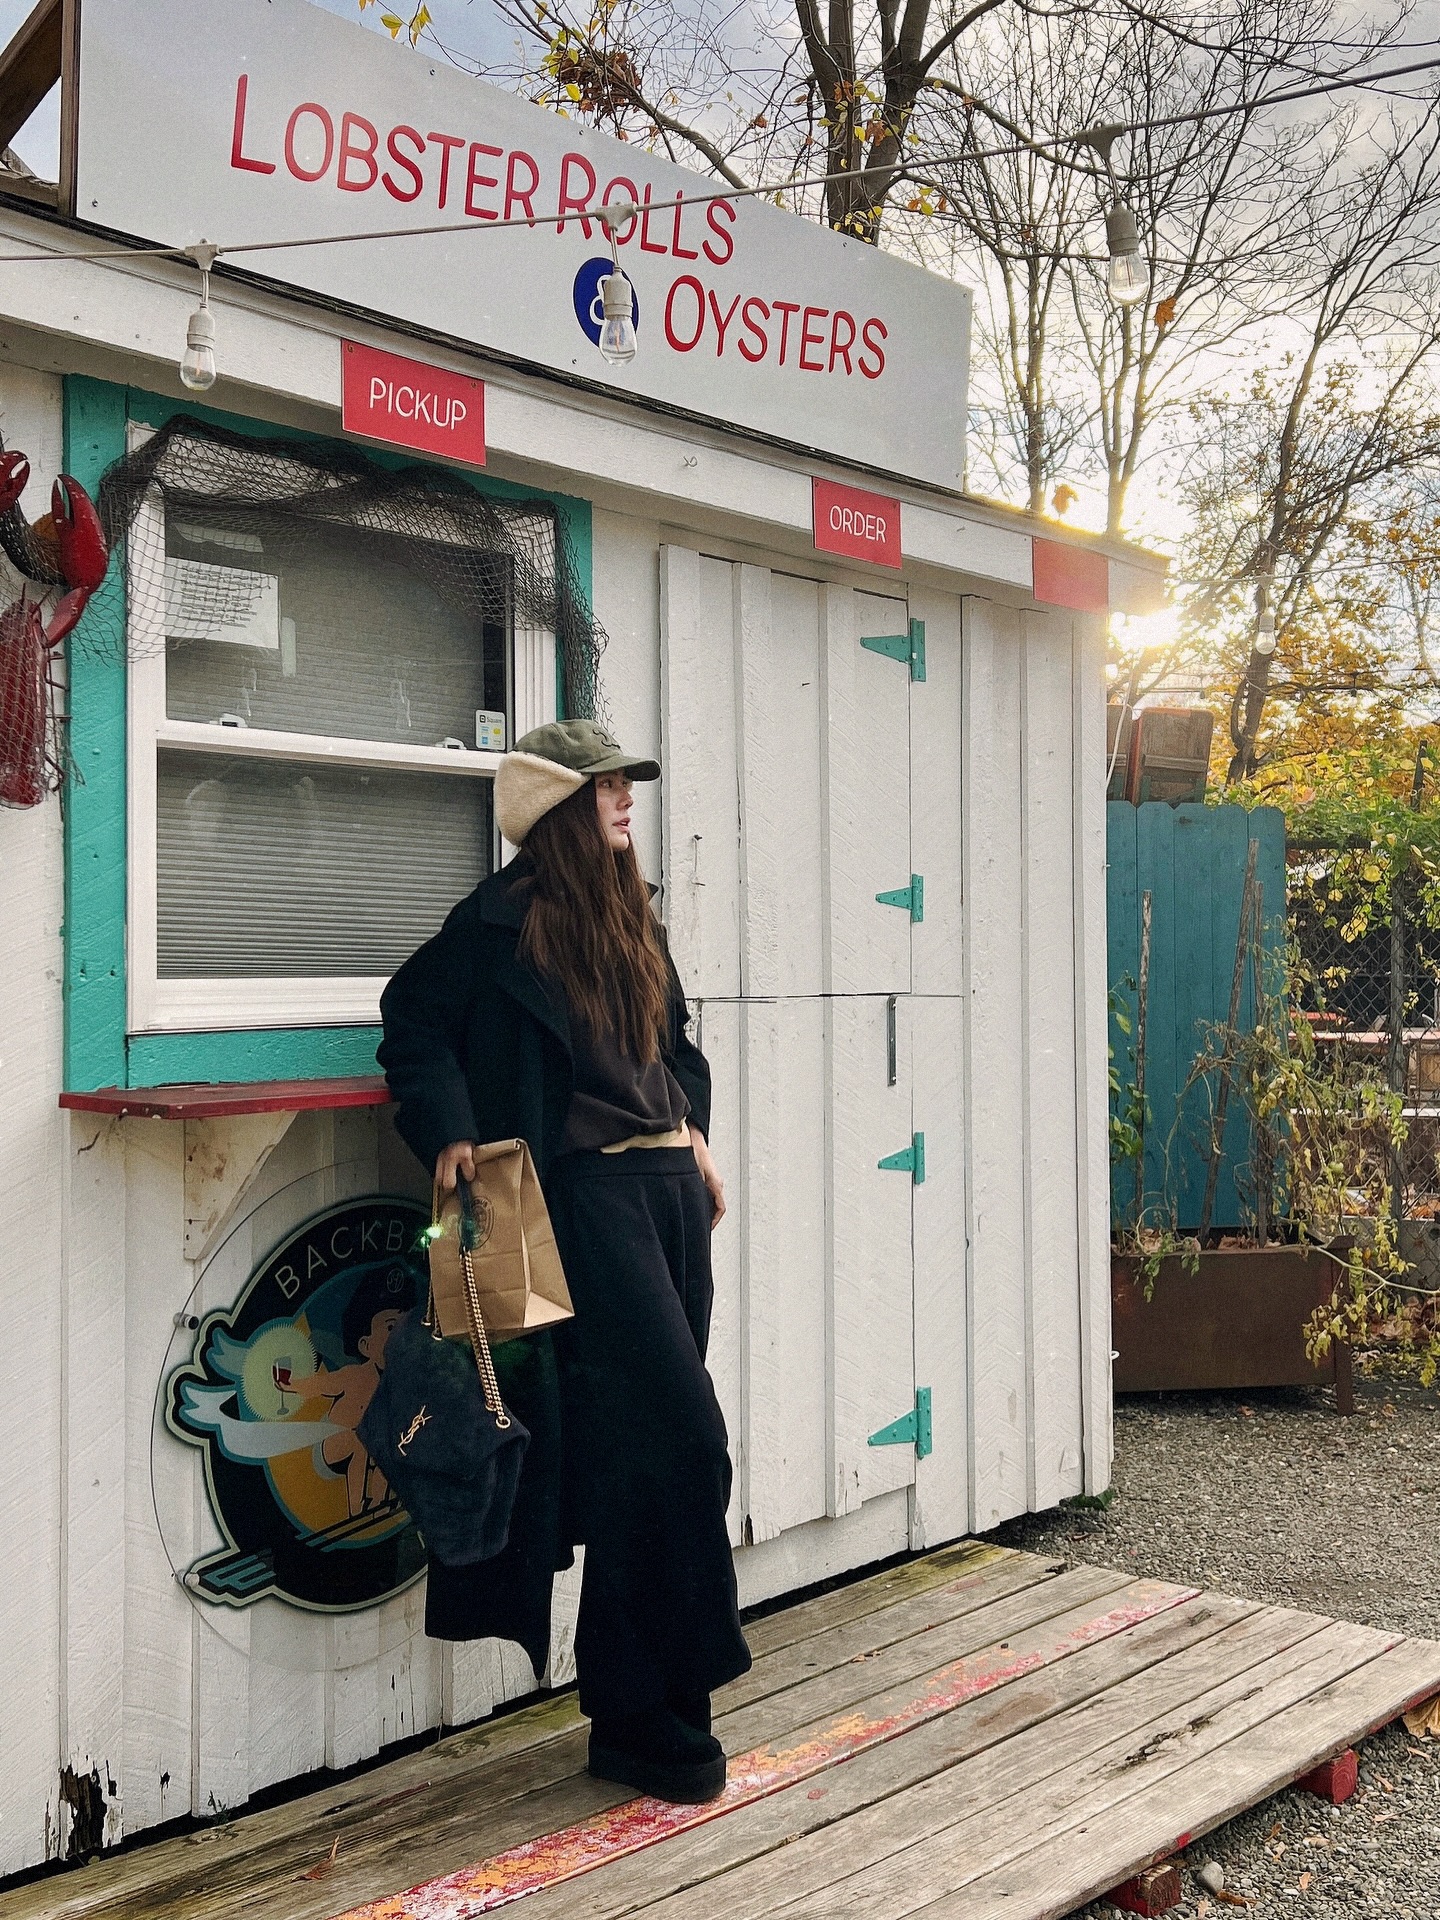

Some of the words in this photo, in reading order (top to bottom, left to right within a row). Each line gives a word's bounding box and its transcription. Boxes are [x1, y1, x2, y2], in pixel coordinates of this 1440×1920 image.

[231, 73, 540, 228] LOBSTER
[556, 152, 737, 266] ROLLS
[664, 274, 888, 380] OYSTERS
[369, 376, 467, 431] PICKUP
[829, 505, 887, 544] ORDER
